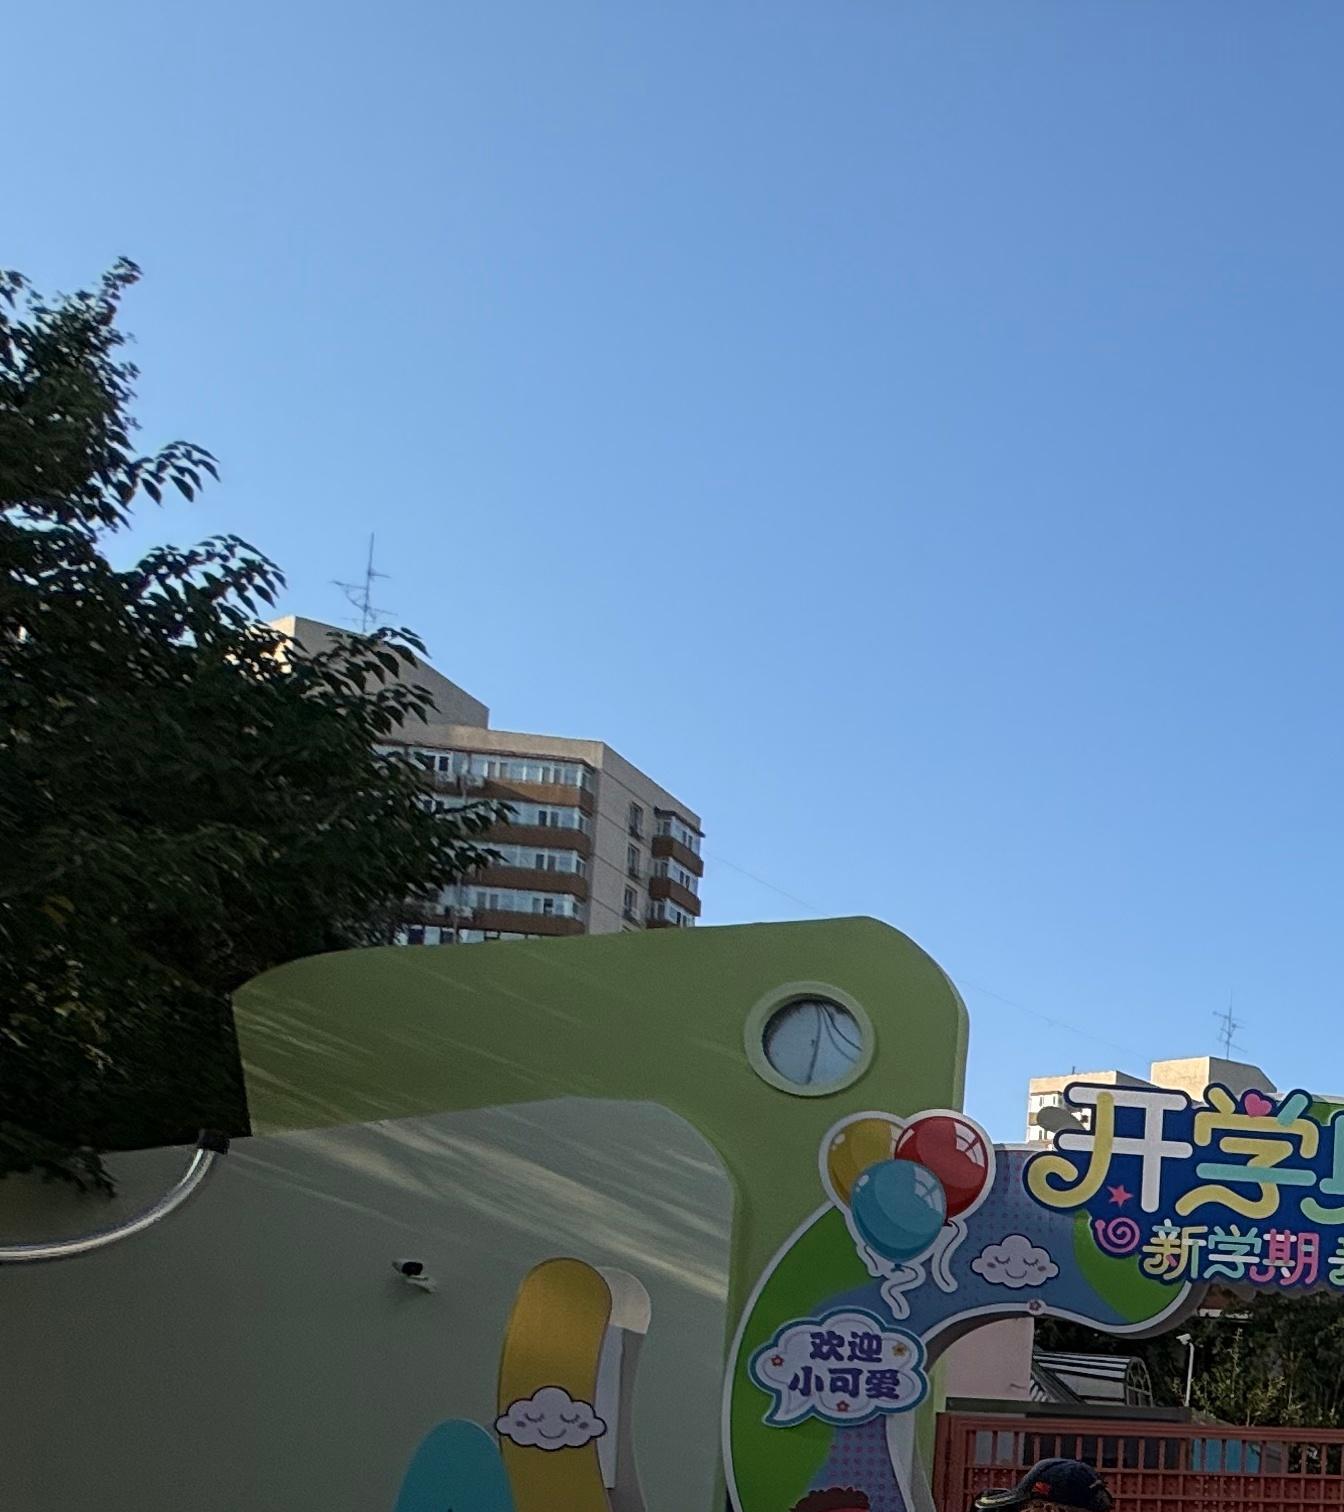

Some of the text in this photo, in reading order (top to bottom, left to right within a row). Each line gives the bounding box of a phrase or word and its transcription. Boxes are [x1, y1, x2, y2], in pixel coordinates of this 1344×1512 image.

[1141, 1218, 1320, 1284] 新学期
[809, 1330, 883, 1363] 欢迎
[788, 1366, 900, 1400] 小可爱
